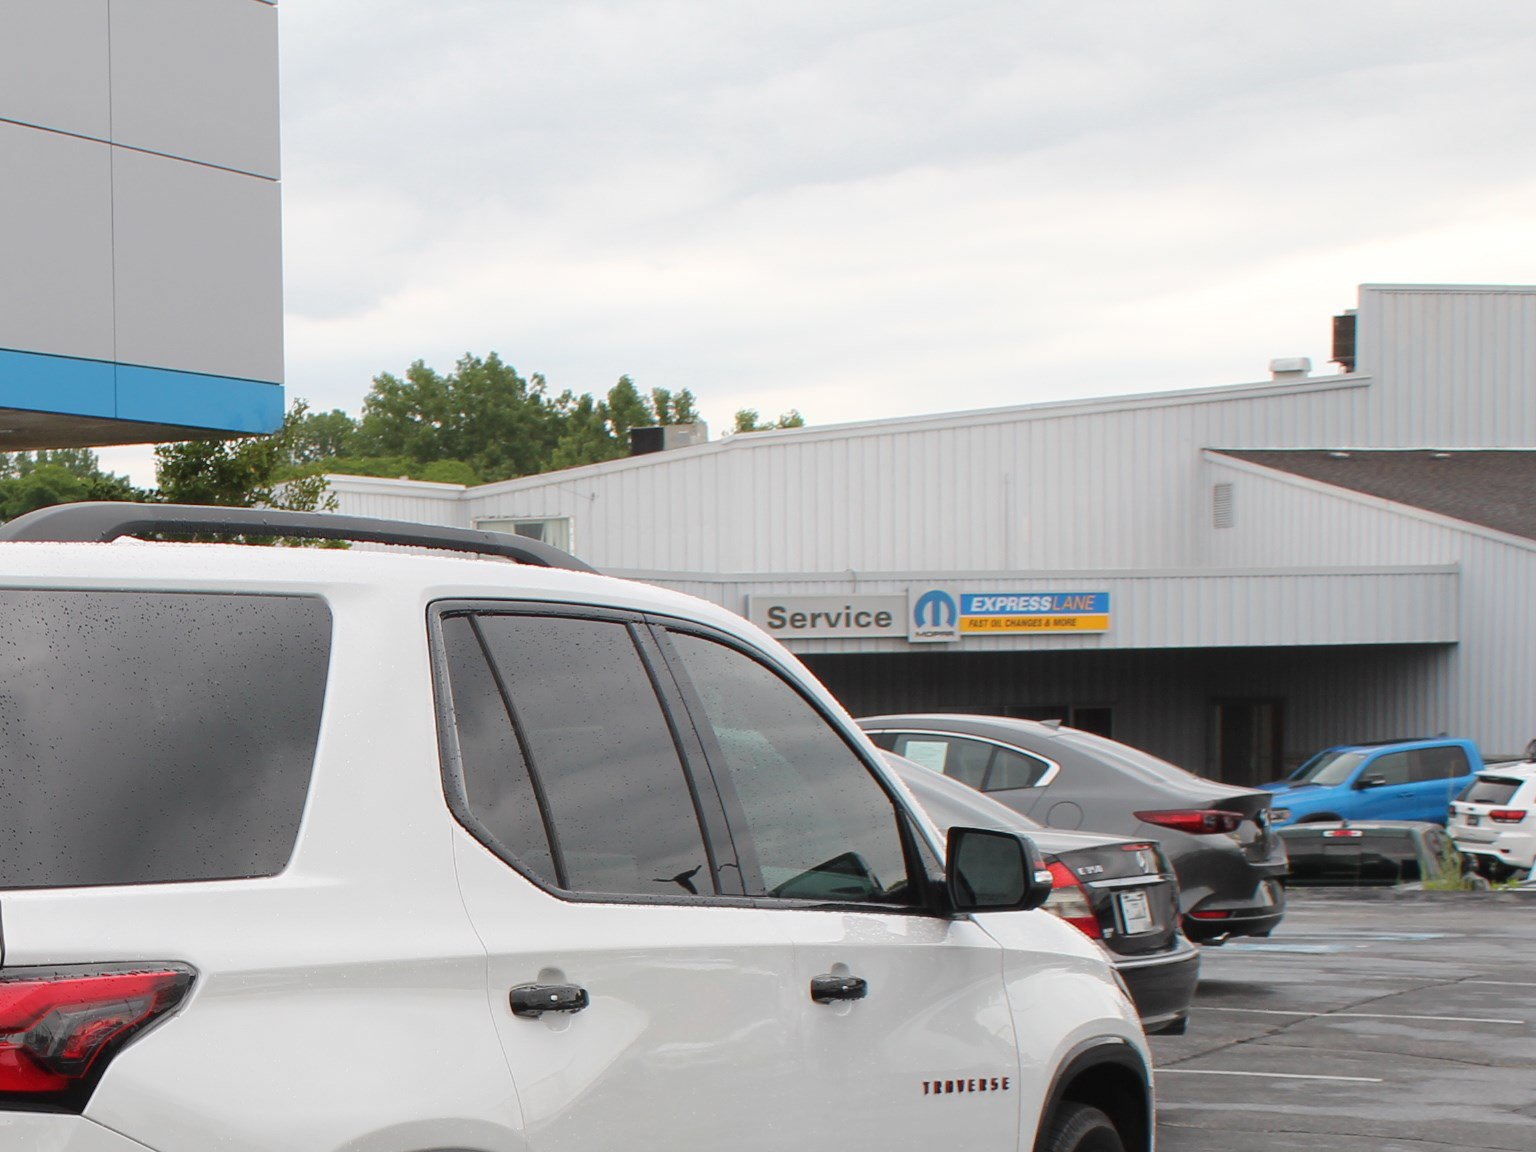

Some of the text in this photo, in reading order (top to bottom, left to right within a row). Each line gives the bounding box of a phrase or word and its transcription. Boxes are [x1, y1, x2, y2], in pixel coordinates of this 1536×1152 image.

[766, 605, 893, 630] Service
[969, 619, 988, 628] FAST
[1005, 618, 1043, 628] CHANGES
[1053, 618, 1077, 627] MORE
[922, 1077, 1010, 1095] TRAVERSE
